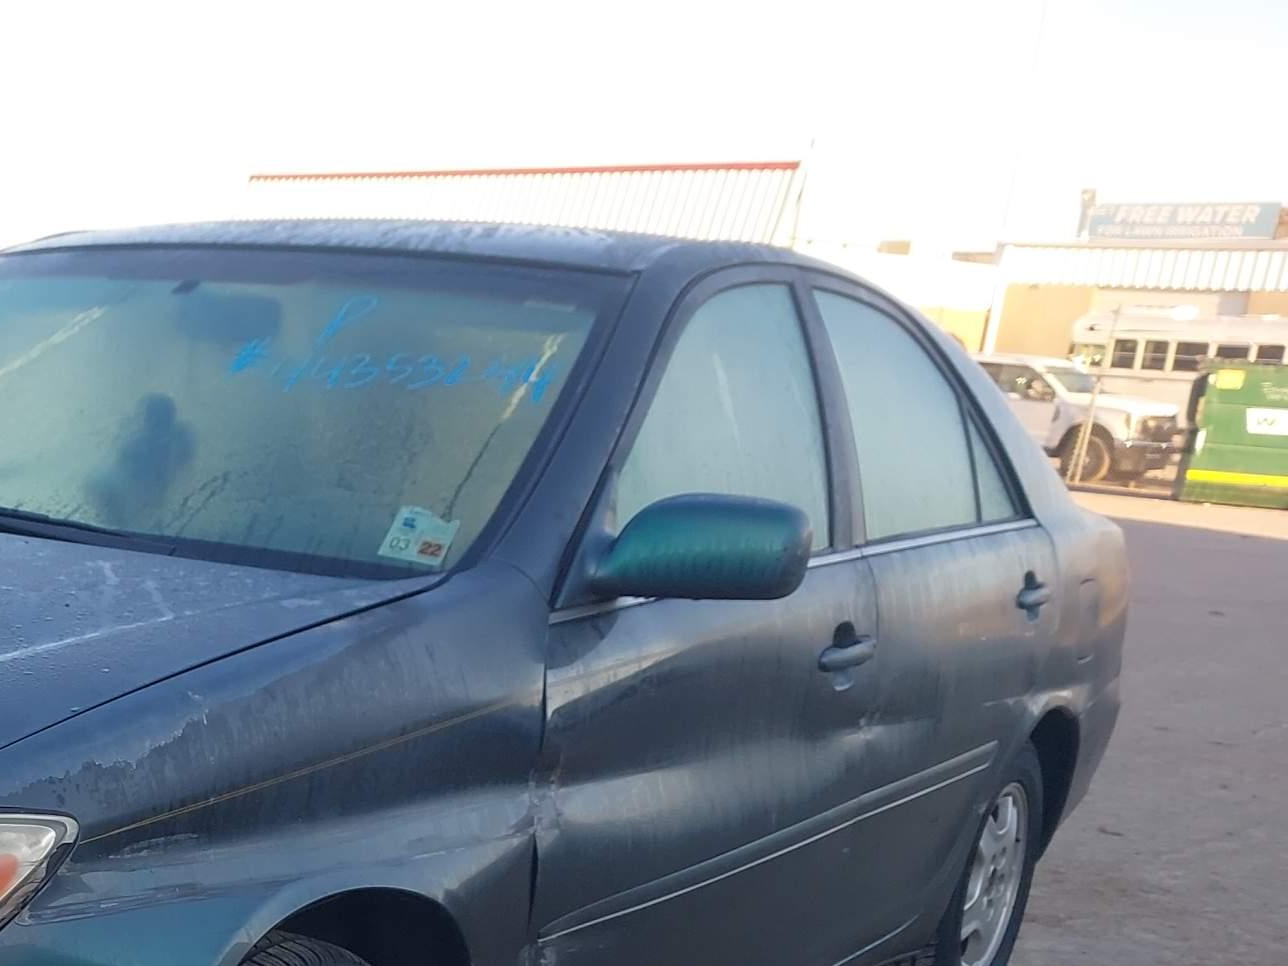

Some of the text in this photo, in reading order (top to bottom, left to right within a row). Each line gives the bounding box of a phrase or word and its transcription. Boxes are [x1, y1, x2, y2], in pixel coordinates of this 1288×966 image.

[1114, 205, 1173, 224] FREE
[1176, 205, 1260, 224] WATER
[389, 537, 441, 557] 03 22
